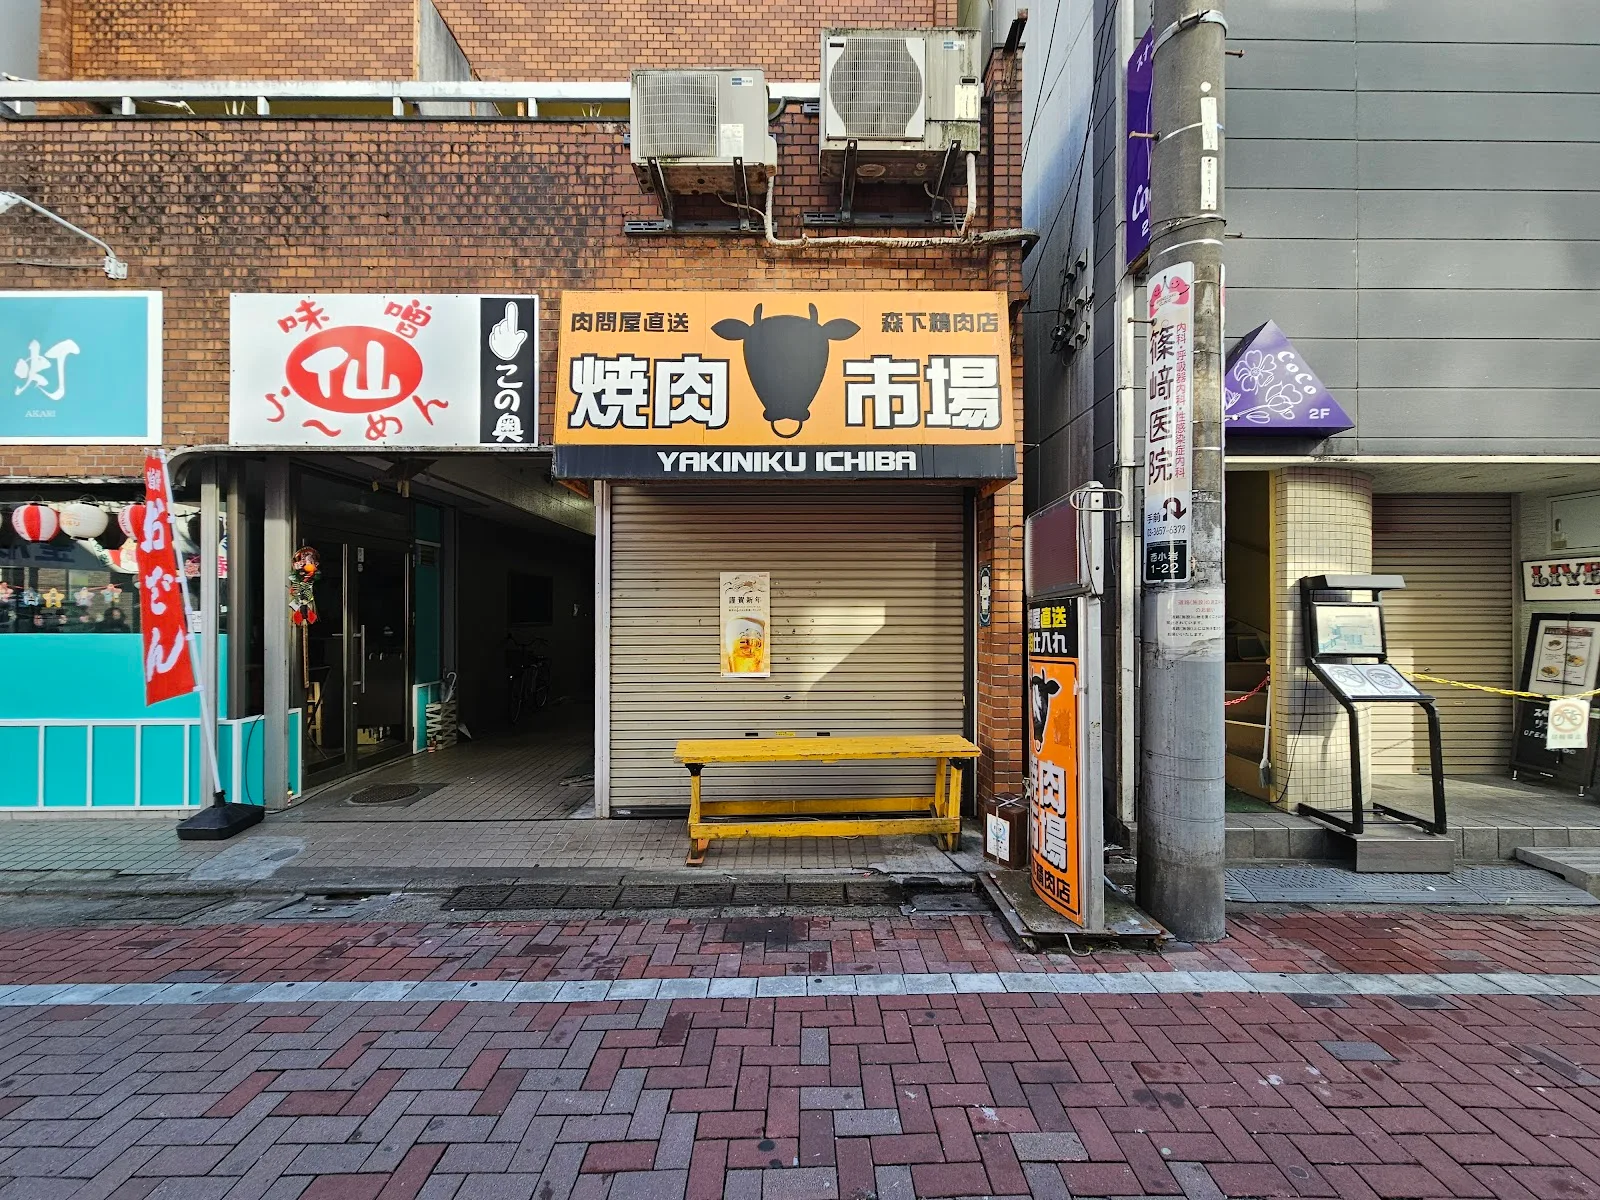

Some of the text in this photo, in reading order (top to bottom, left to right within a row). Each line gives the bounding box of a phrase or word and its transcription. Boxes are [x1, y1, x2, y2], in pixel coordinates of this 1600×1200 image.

[570, 311, 690, 333] 肉問屋直送
[881, 311, 999, 333] 森下精肉店
[14, 339, 80, 401] 灯
[300, 340, 401, 399] 仙
[492, 363, 524, 442] この奥
[567, 352, 1003, 431] 焼肉 市場
[25, 409, 56, 418] AKARI
[1309, 408, 1331, 420] 2F
[656, 450, 917, 473] YAKINIKU ICHIBA
[1147, 512, 1161, 525] 手前
[1151, 563, 1179, 574] 1-22
[141, 497, 186, 686] おでん
